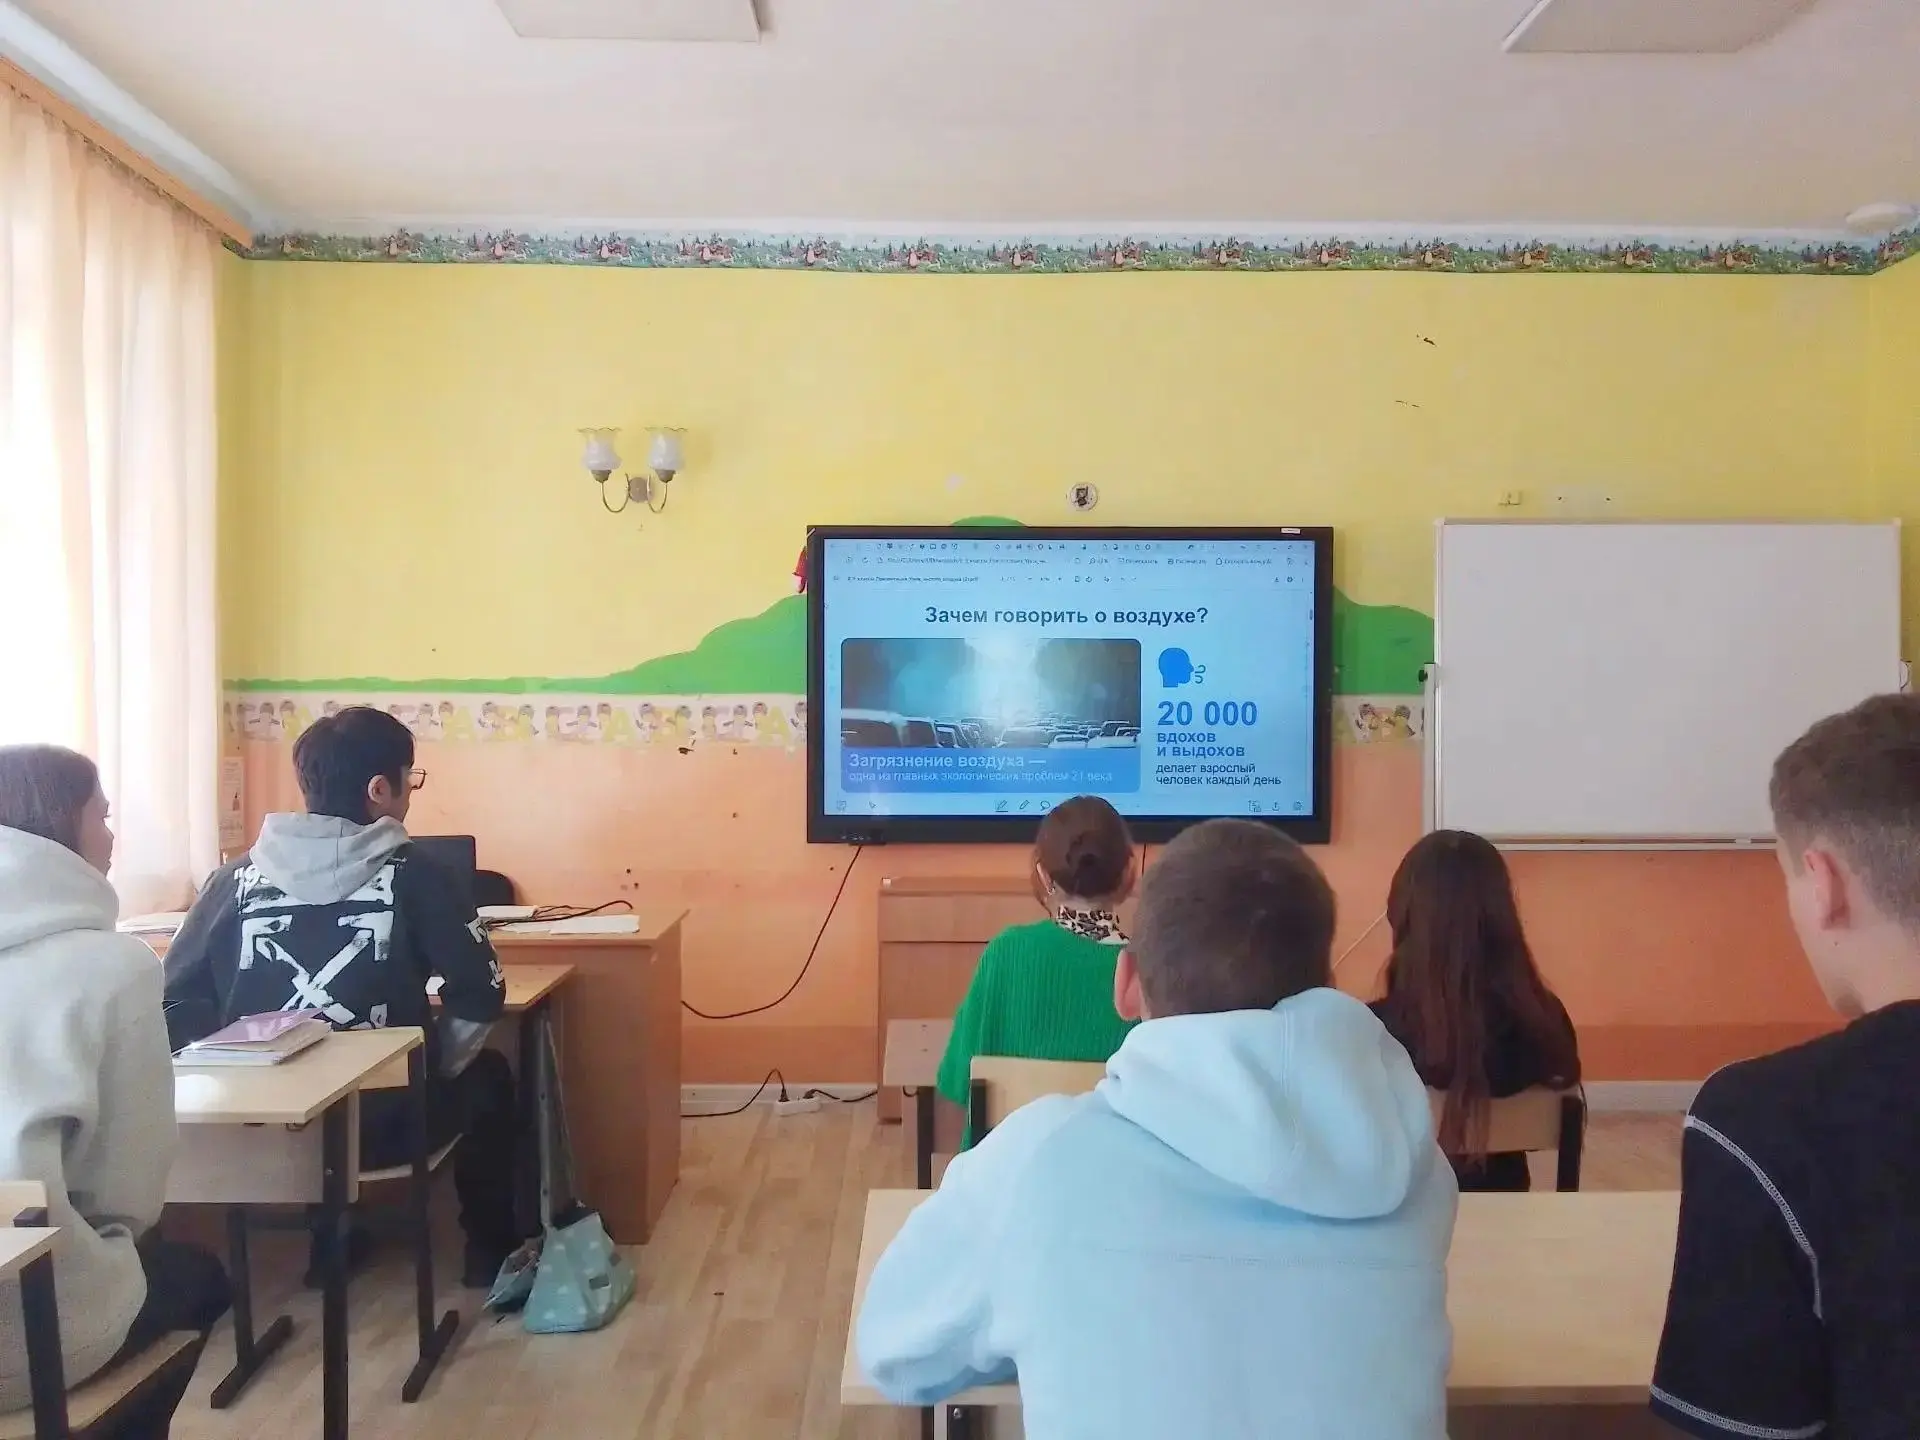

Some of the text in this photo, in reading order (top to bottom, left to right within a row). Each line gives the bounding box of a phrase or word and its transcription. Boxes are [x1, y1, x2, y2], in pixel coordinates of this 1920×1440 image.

[925, 606, 1209, 628] Зачем говорить о воздухе?
[1157, 701, 1258, 726] 20 000
[1157, 732, 1217, 744] вдохов
[1157, 746, 1246, 760] и выдохов
[849, 753, 953, 771] Загрязнение
[958, 755, 1025, 770] воздуха
[1155, 764, 1256, 777] делает взрослый
[848, 773, 876, 784] одна
[878, 773, 891, 782] из
[893, 773, 938, 783] главных
[940, 773, 1019, 784] экологических
[1021, 773, 1070, 783] проблем
[1086, 773, 1114, 782] века
[1155, 775, 1282, 787] человек каждый день
